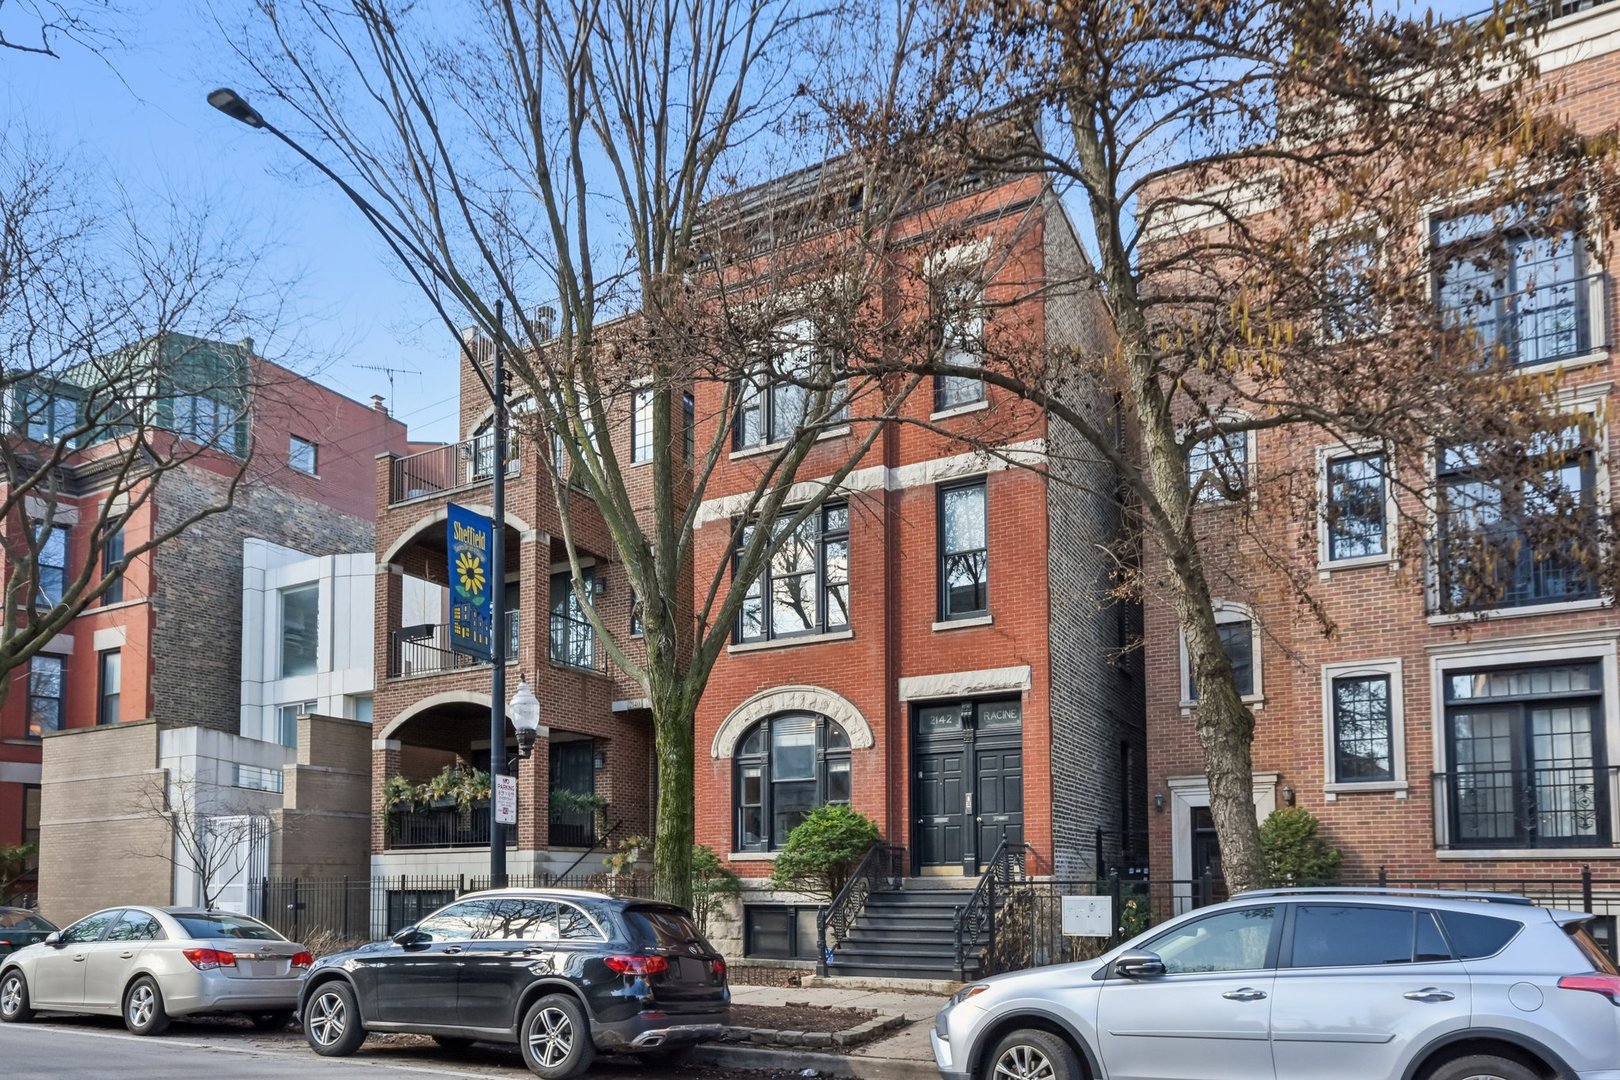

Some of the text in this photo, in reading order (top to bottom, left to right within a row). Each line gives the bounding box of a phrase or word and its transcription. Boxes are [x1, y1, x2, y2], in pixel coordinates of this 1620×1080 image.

[453, 520, 486, 551] Sheffield
[930, 709, 1018, 725] 2142 RACINE
[497, 783, 515, 791] PARKING
